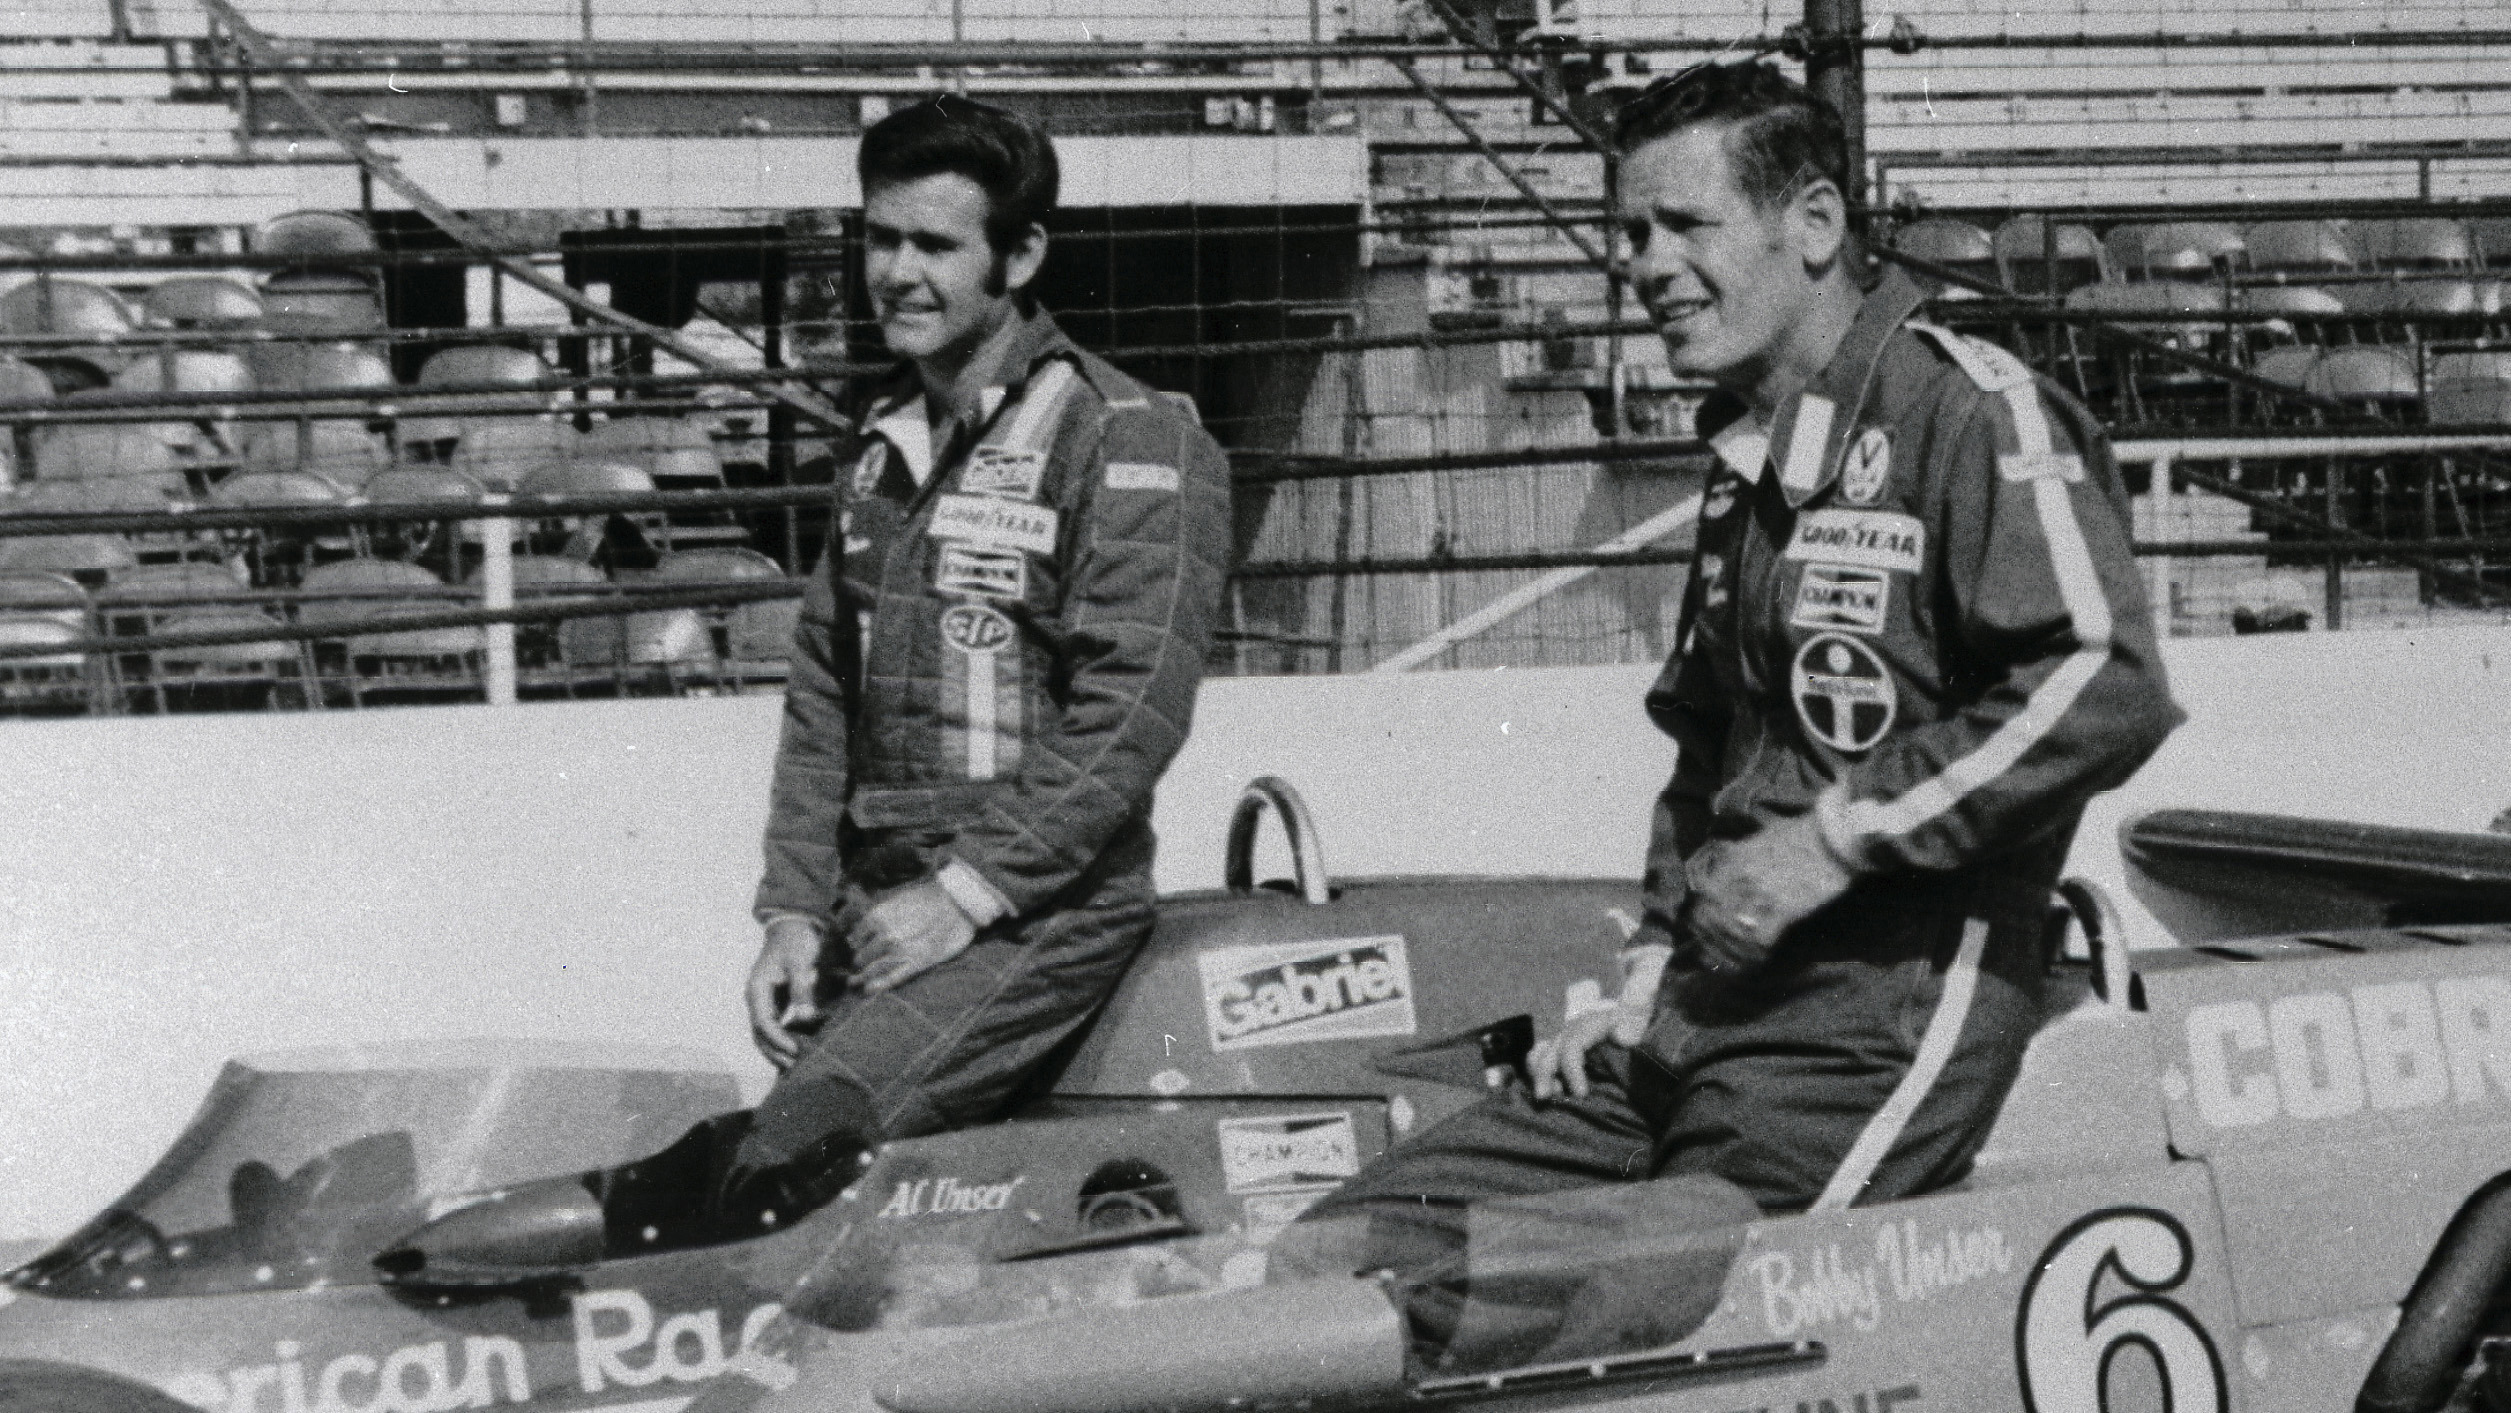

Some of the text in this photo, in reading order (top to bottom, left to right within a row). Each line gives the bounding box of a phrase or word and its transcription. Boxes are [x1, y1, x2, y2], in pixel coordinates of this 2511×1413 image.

[948, 613, 1010, 646] STP
[1217, 942, 1402, 1036] Gabriel
[1234, 1138, 1344, 1167] CHAMPION
[877, 1175, 1026, 1218] Al Unser
[1748, 1217, 2013, 1337] Bobby Unser
[2014, 1206, 2230, 1413] 6
